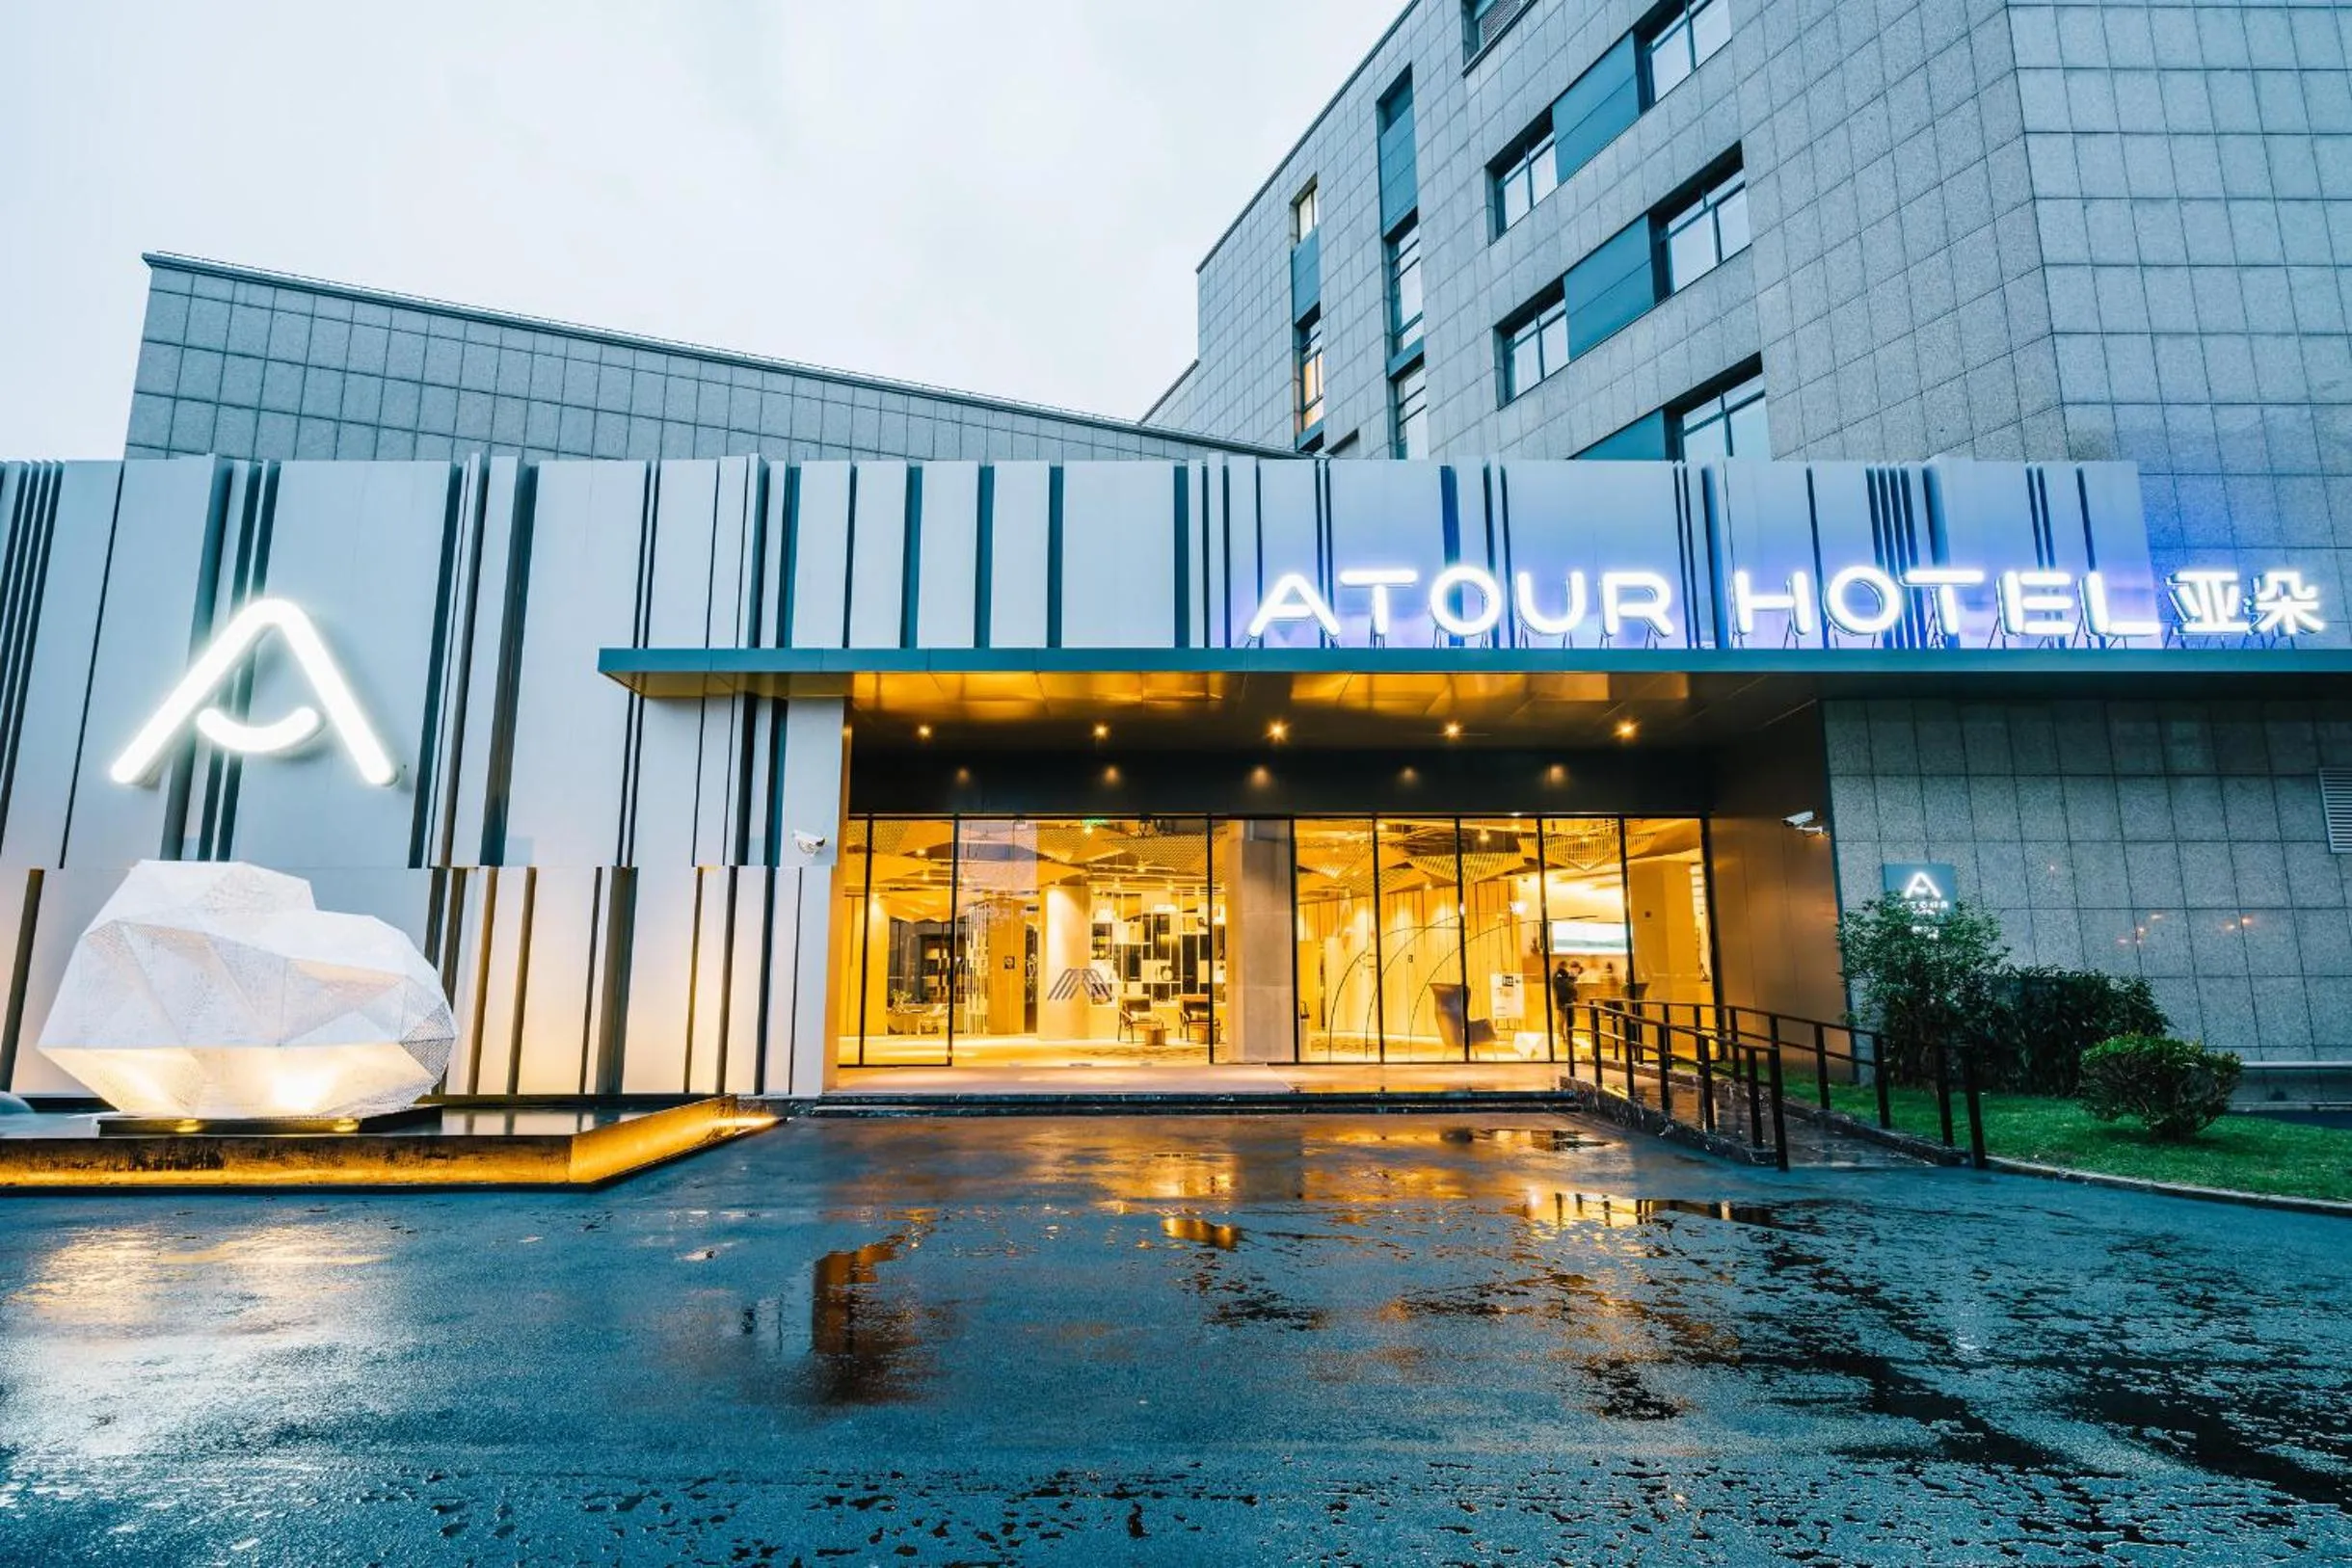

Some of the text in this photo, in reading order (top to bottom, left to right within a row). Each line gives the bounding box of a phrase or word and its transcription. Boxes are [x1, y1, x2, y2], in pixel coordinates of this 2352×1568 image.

[1247, 566, 2324, 637] ATOUR HOTEL 亚朵
